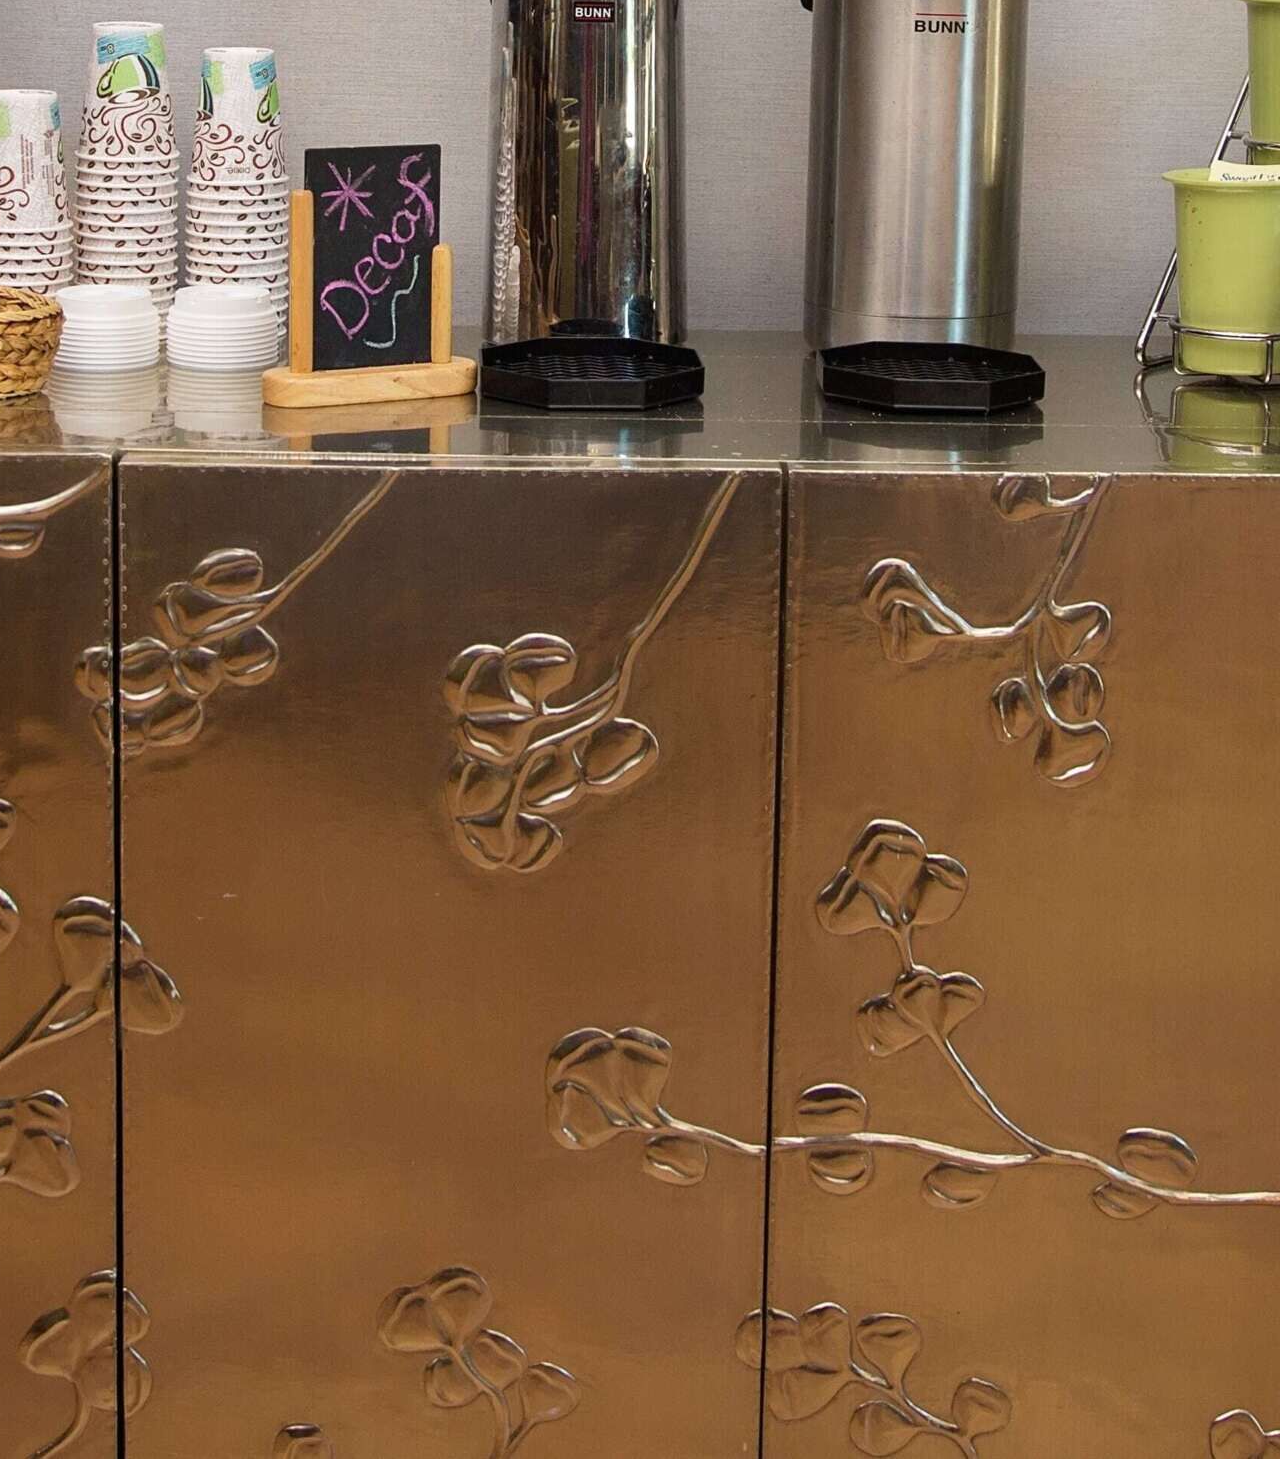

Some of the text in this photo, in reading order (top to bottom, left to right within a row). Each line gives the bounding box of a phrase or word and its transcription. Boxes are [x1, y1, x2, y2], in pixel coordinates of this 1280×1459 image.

[574, 6, 612, 19] BUNN
[914, 20, 966, 34] BUNN
[319, 152, 436, 341] Decaf
